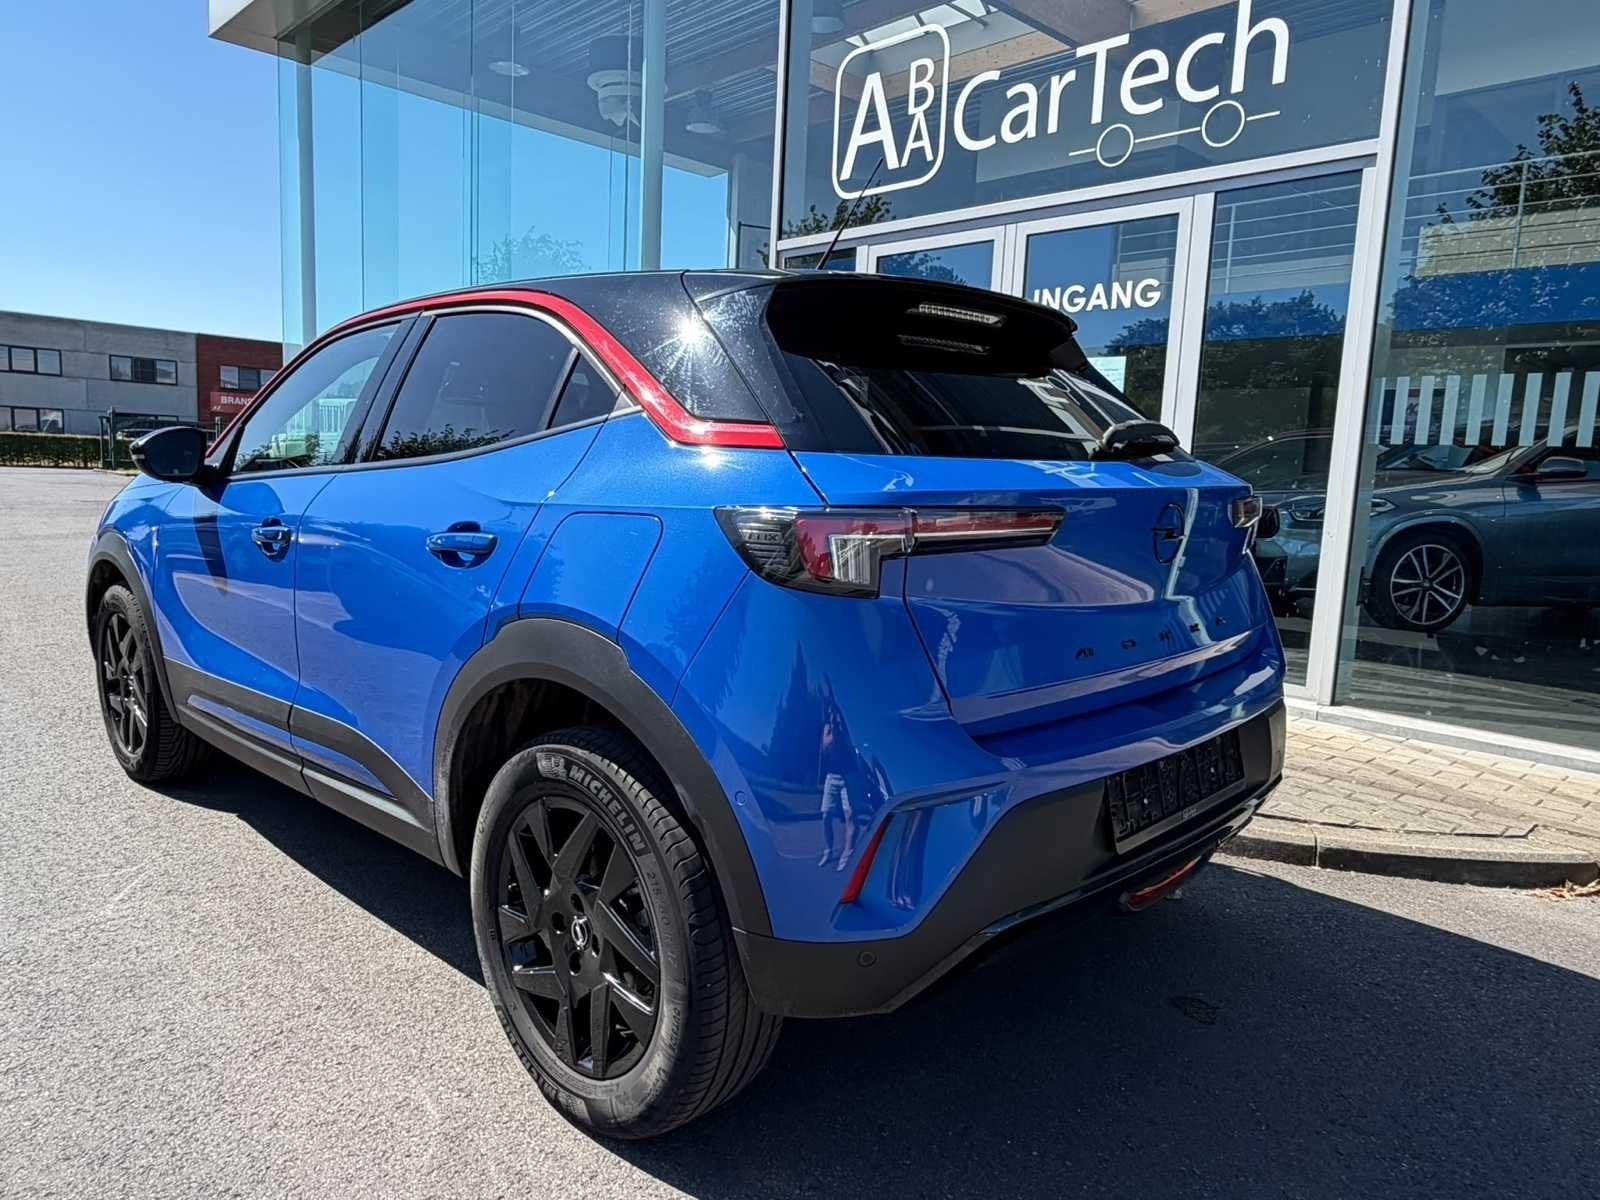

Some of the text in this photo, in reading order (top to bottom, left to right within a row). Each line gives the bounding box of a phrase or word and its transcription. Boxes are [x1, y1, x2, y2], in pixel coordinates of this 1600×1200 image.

[953, 0, 1290, 152] CarTech
[1033, 278, 1161, 313] INGANG
[568, 765, 646, 851] MICHELIN
